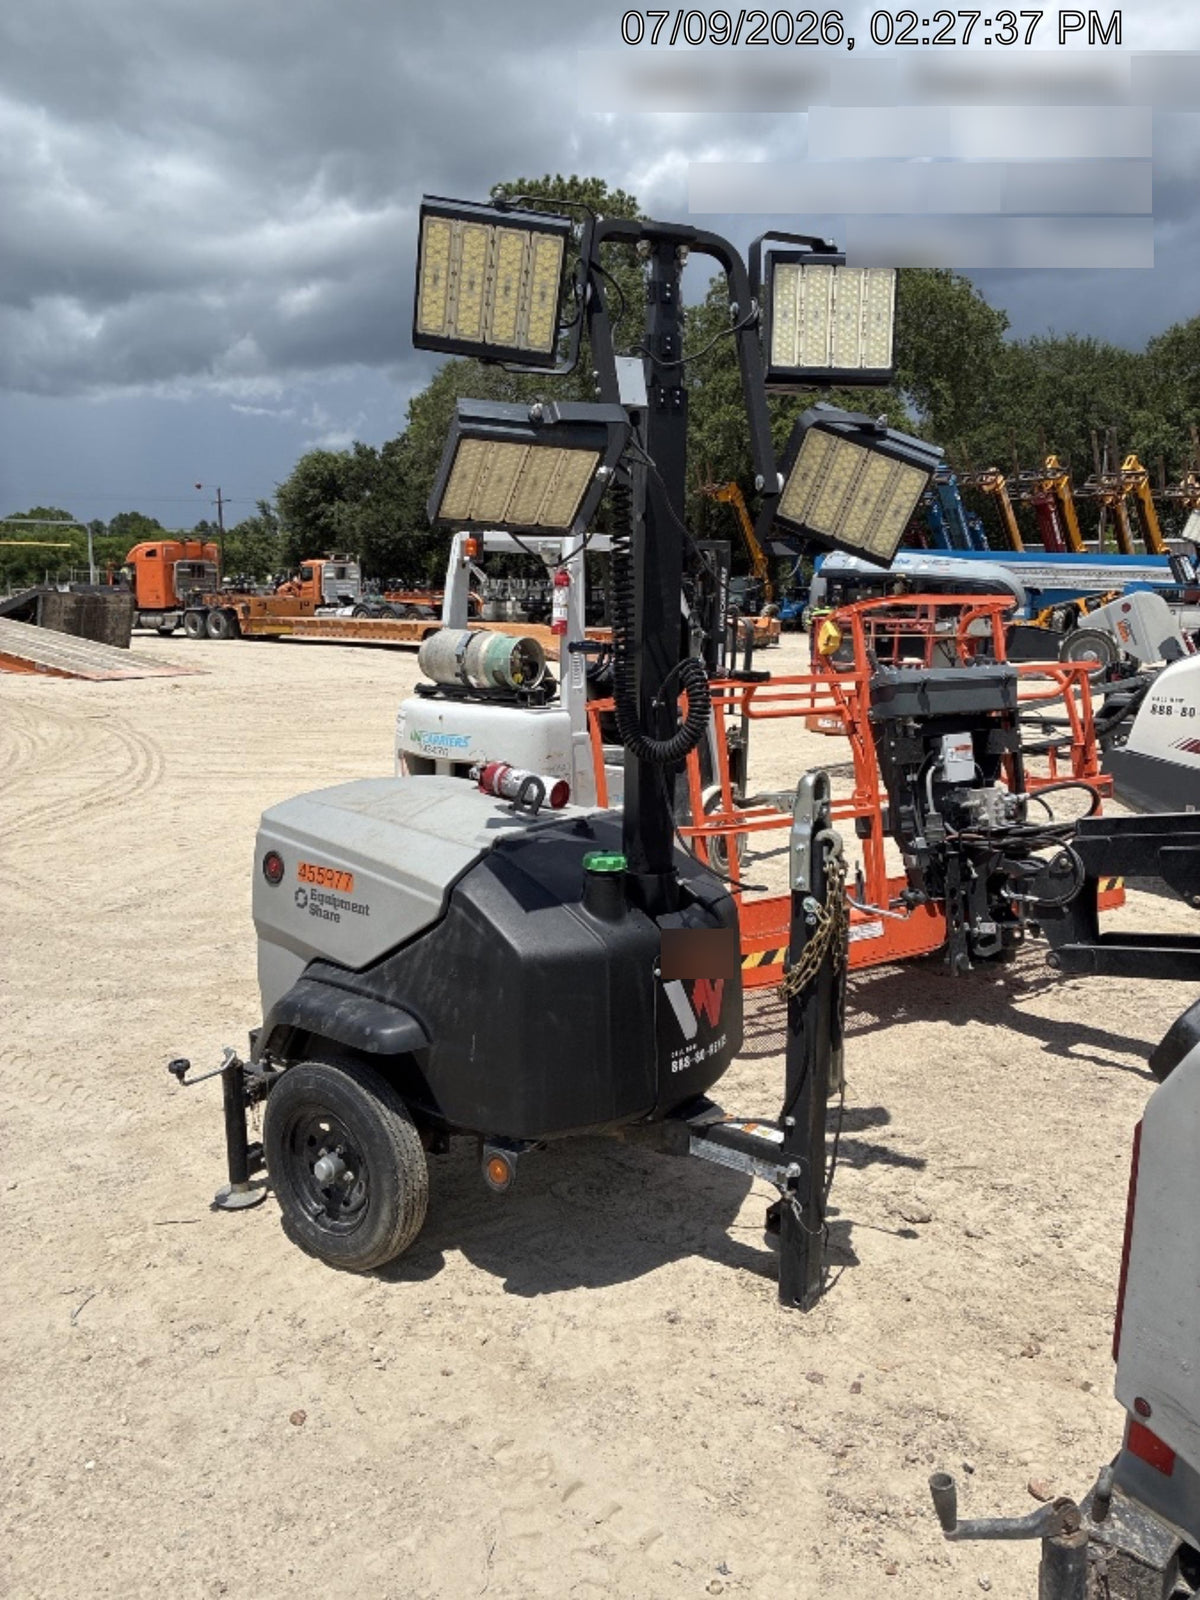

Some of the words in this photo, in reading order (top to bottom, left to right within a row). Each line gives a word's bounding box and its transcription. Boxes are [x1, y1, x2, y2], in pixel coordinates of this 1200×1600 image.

[298, 863, 353, 892] 455977
[309, 902, 341, 924] Share
[310, 888, 370, 916] Equipment
